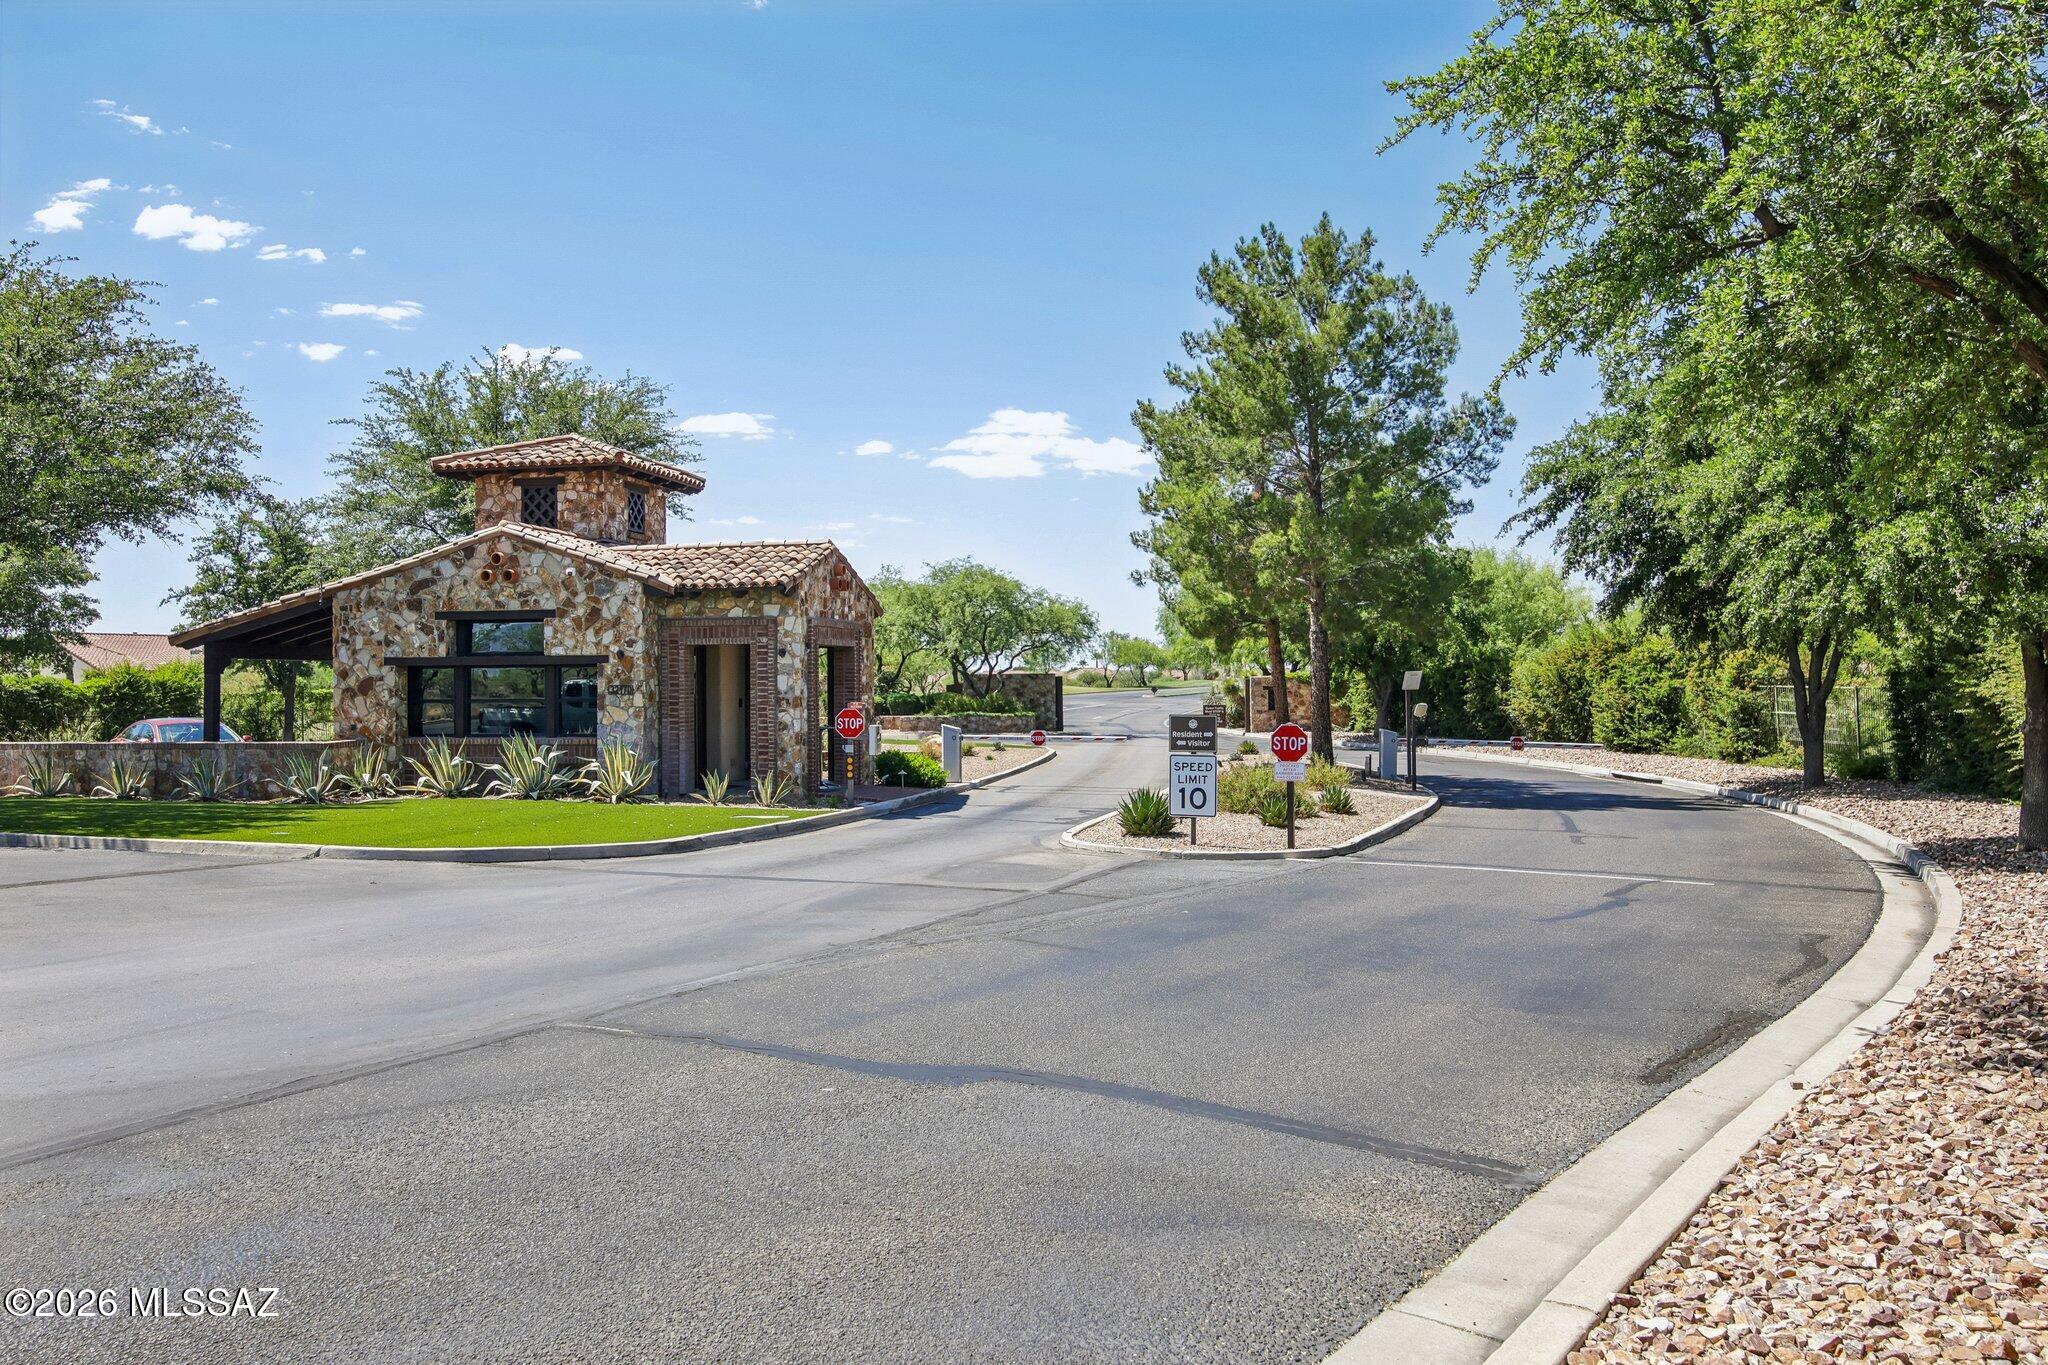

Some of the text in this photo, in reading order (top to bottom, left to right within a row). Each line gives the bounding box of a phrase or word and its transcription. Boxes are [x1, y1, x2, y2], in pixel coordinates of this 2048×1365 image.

[837, 717, 863, 729] STOP
[1172, 730, 1202, 738] Resident
[1273, 736, 1306, 751] STOP
[1173, 761, 1213, 772] SPEED
[1177, 774, 1208, 785] LIMIT
[1178, 787, 1207, 810] 10
